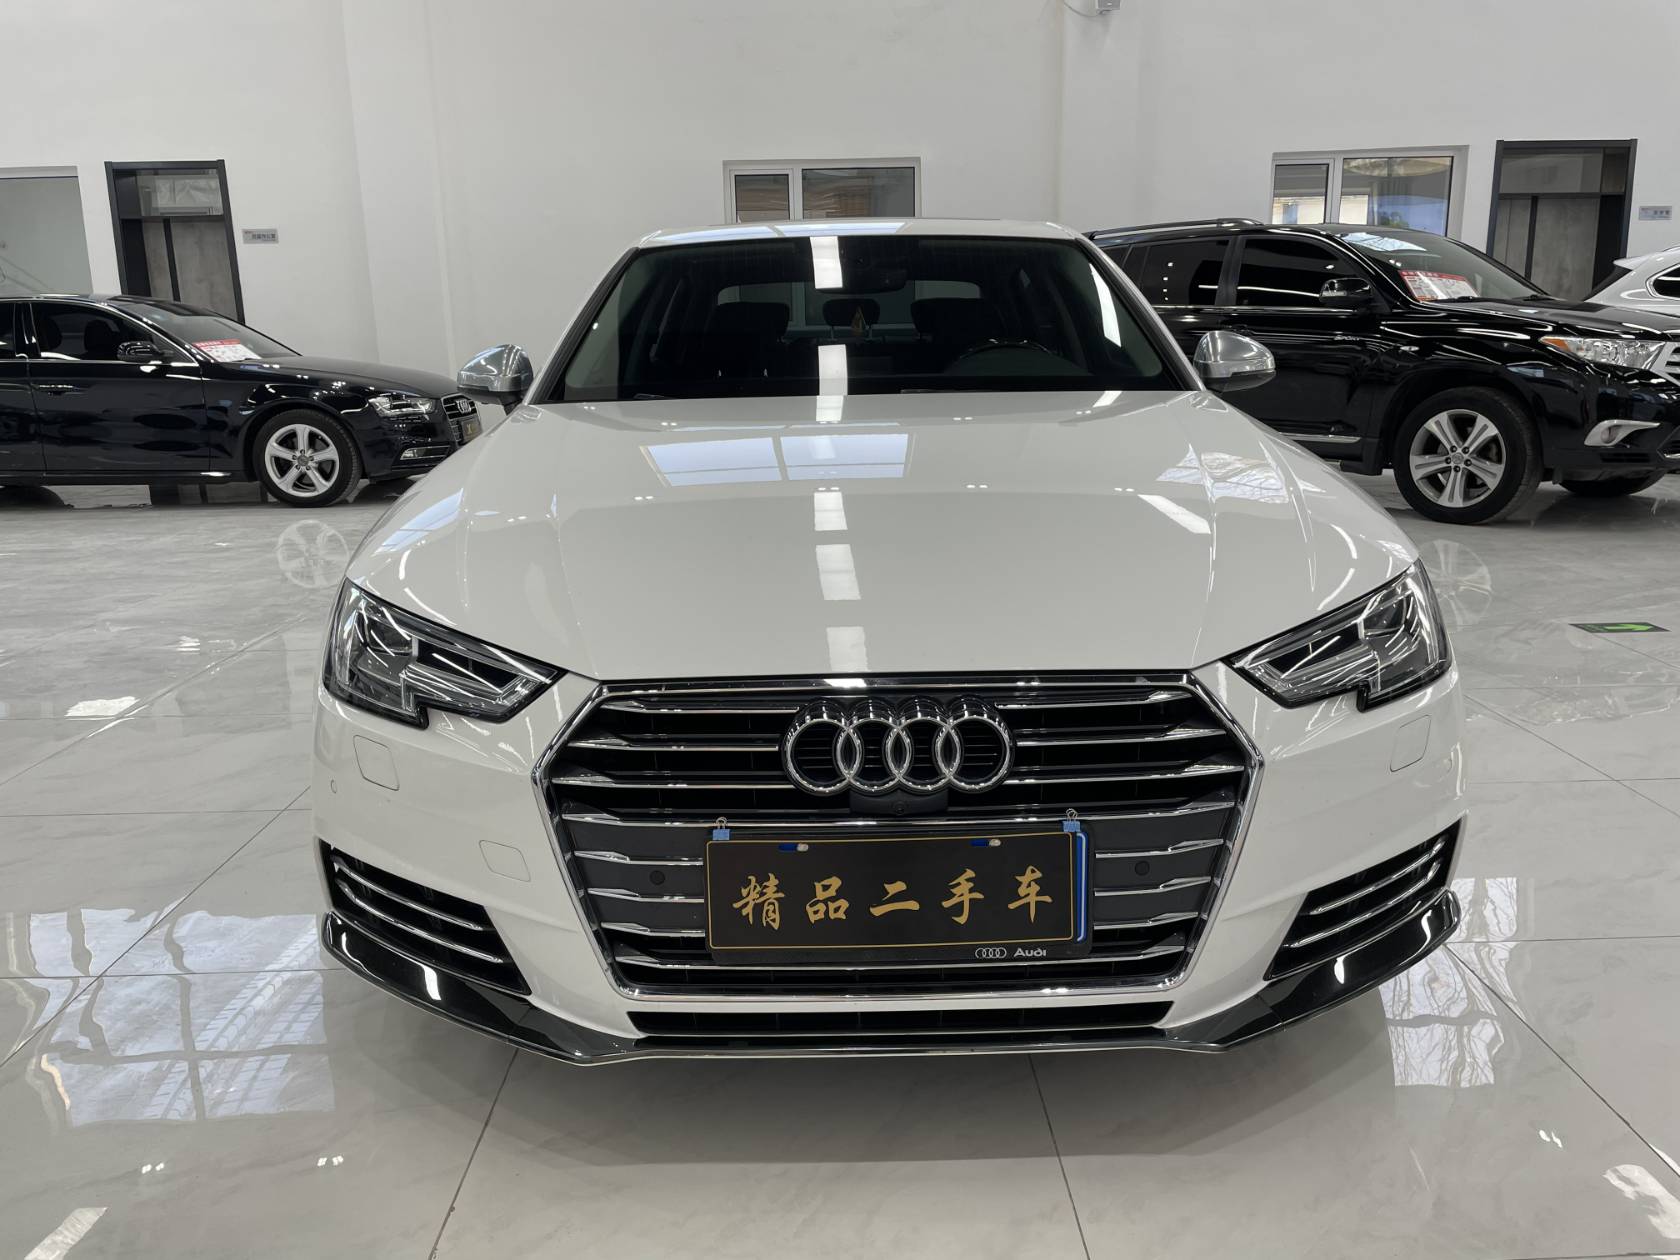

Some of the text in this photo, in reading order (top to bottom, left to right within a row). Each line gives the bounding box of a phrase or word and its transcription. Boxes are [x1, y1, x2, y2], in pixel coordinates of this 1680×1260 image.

[733, 865, 1052, 930] 精品二手车
[1013, 947, 1047, 957] Audi
